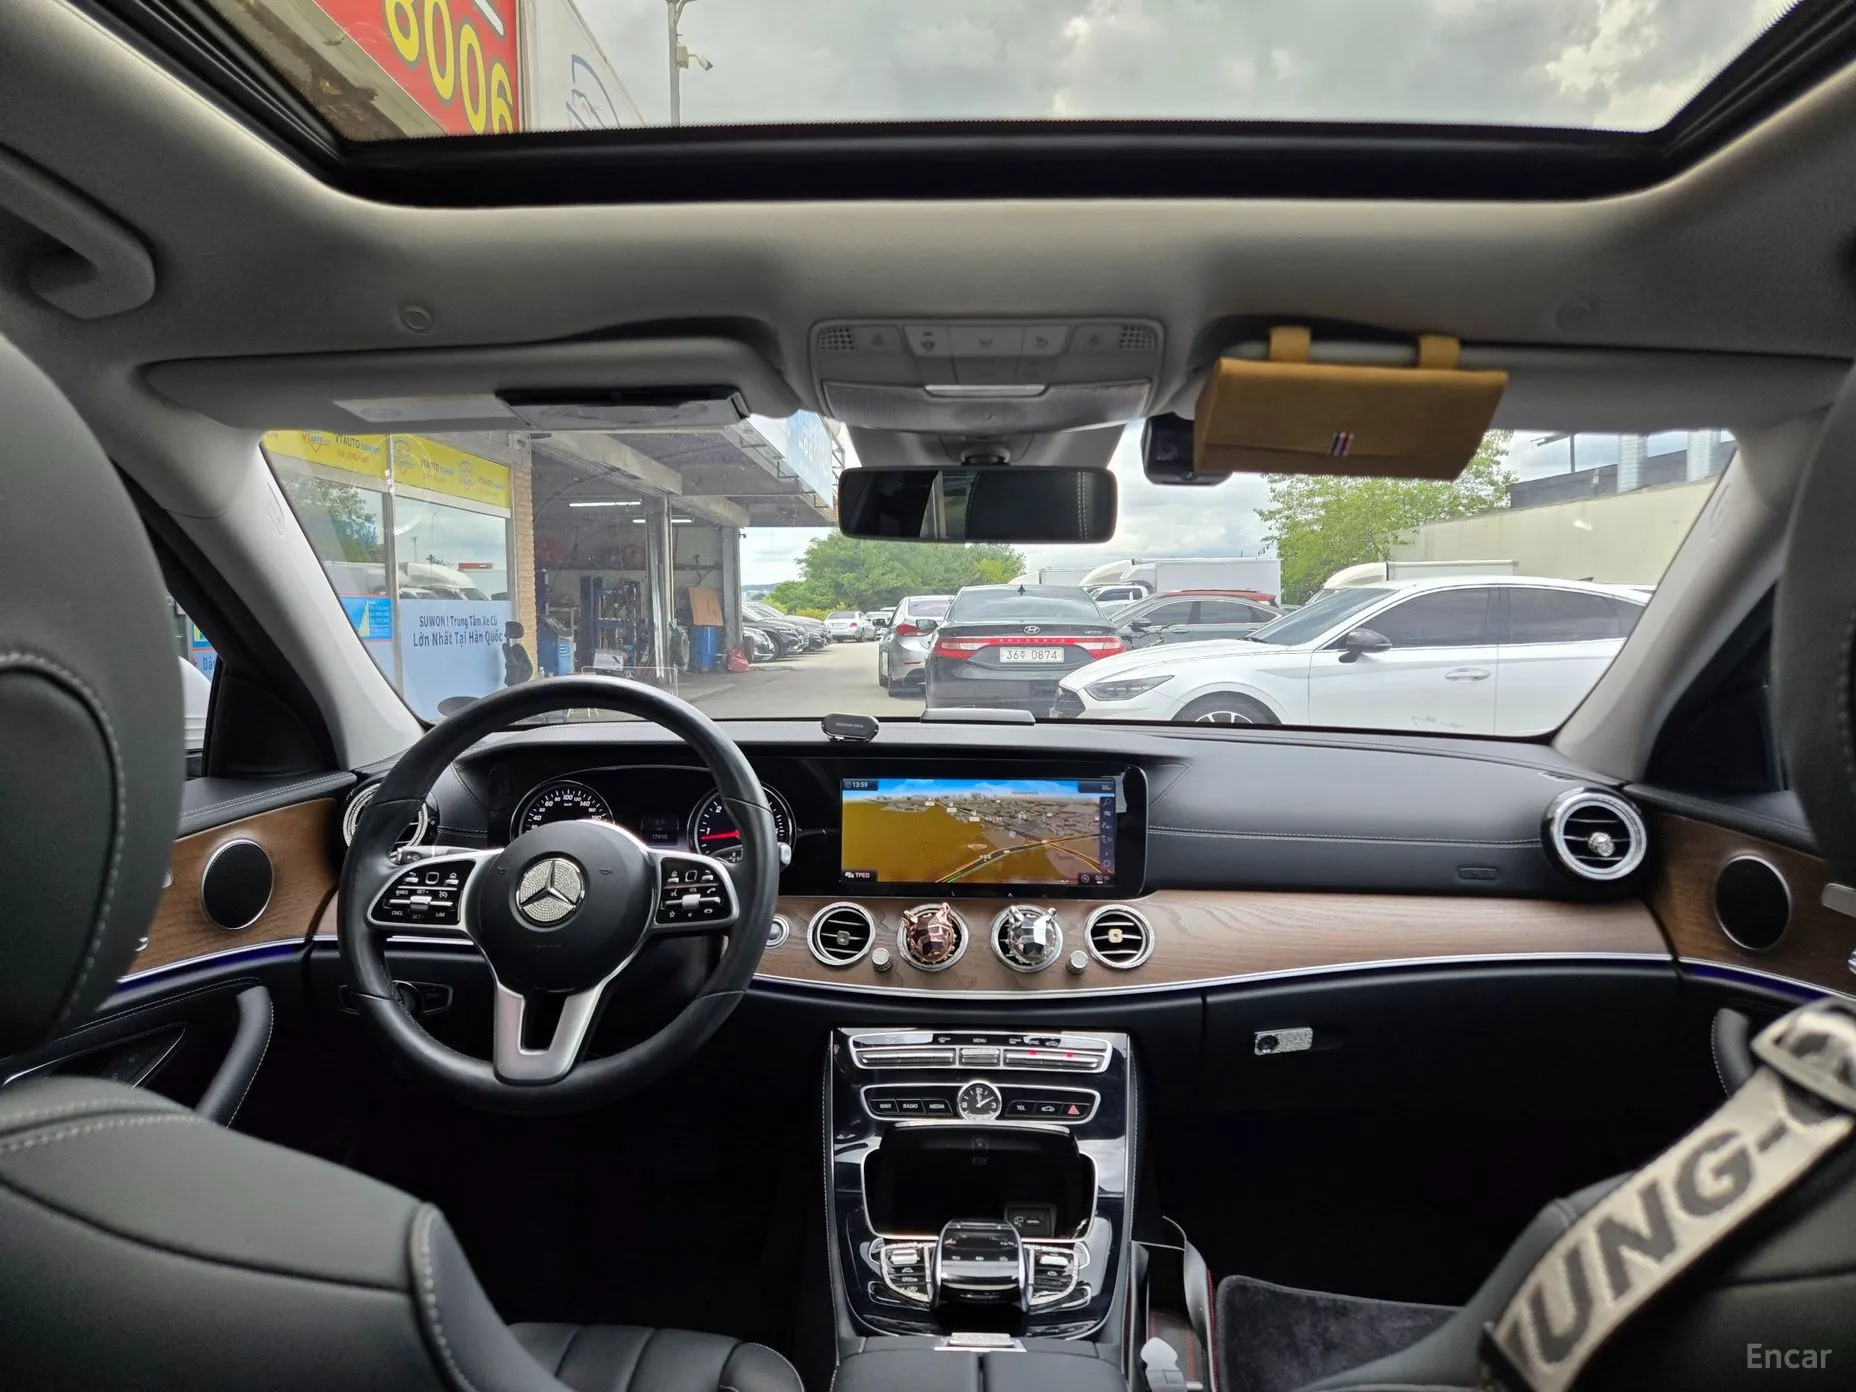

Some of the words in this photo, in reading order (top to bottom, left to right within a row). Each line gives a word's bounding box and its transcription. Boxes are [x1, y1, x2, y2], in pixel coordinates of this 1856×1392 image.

[450, 615, 469, 630] Trung
[1031, 650, 1058, 660] 0874
[715, 805, 722, 813] 2
